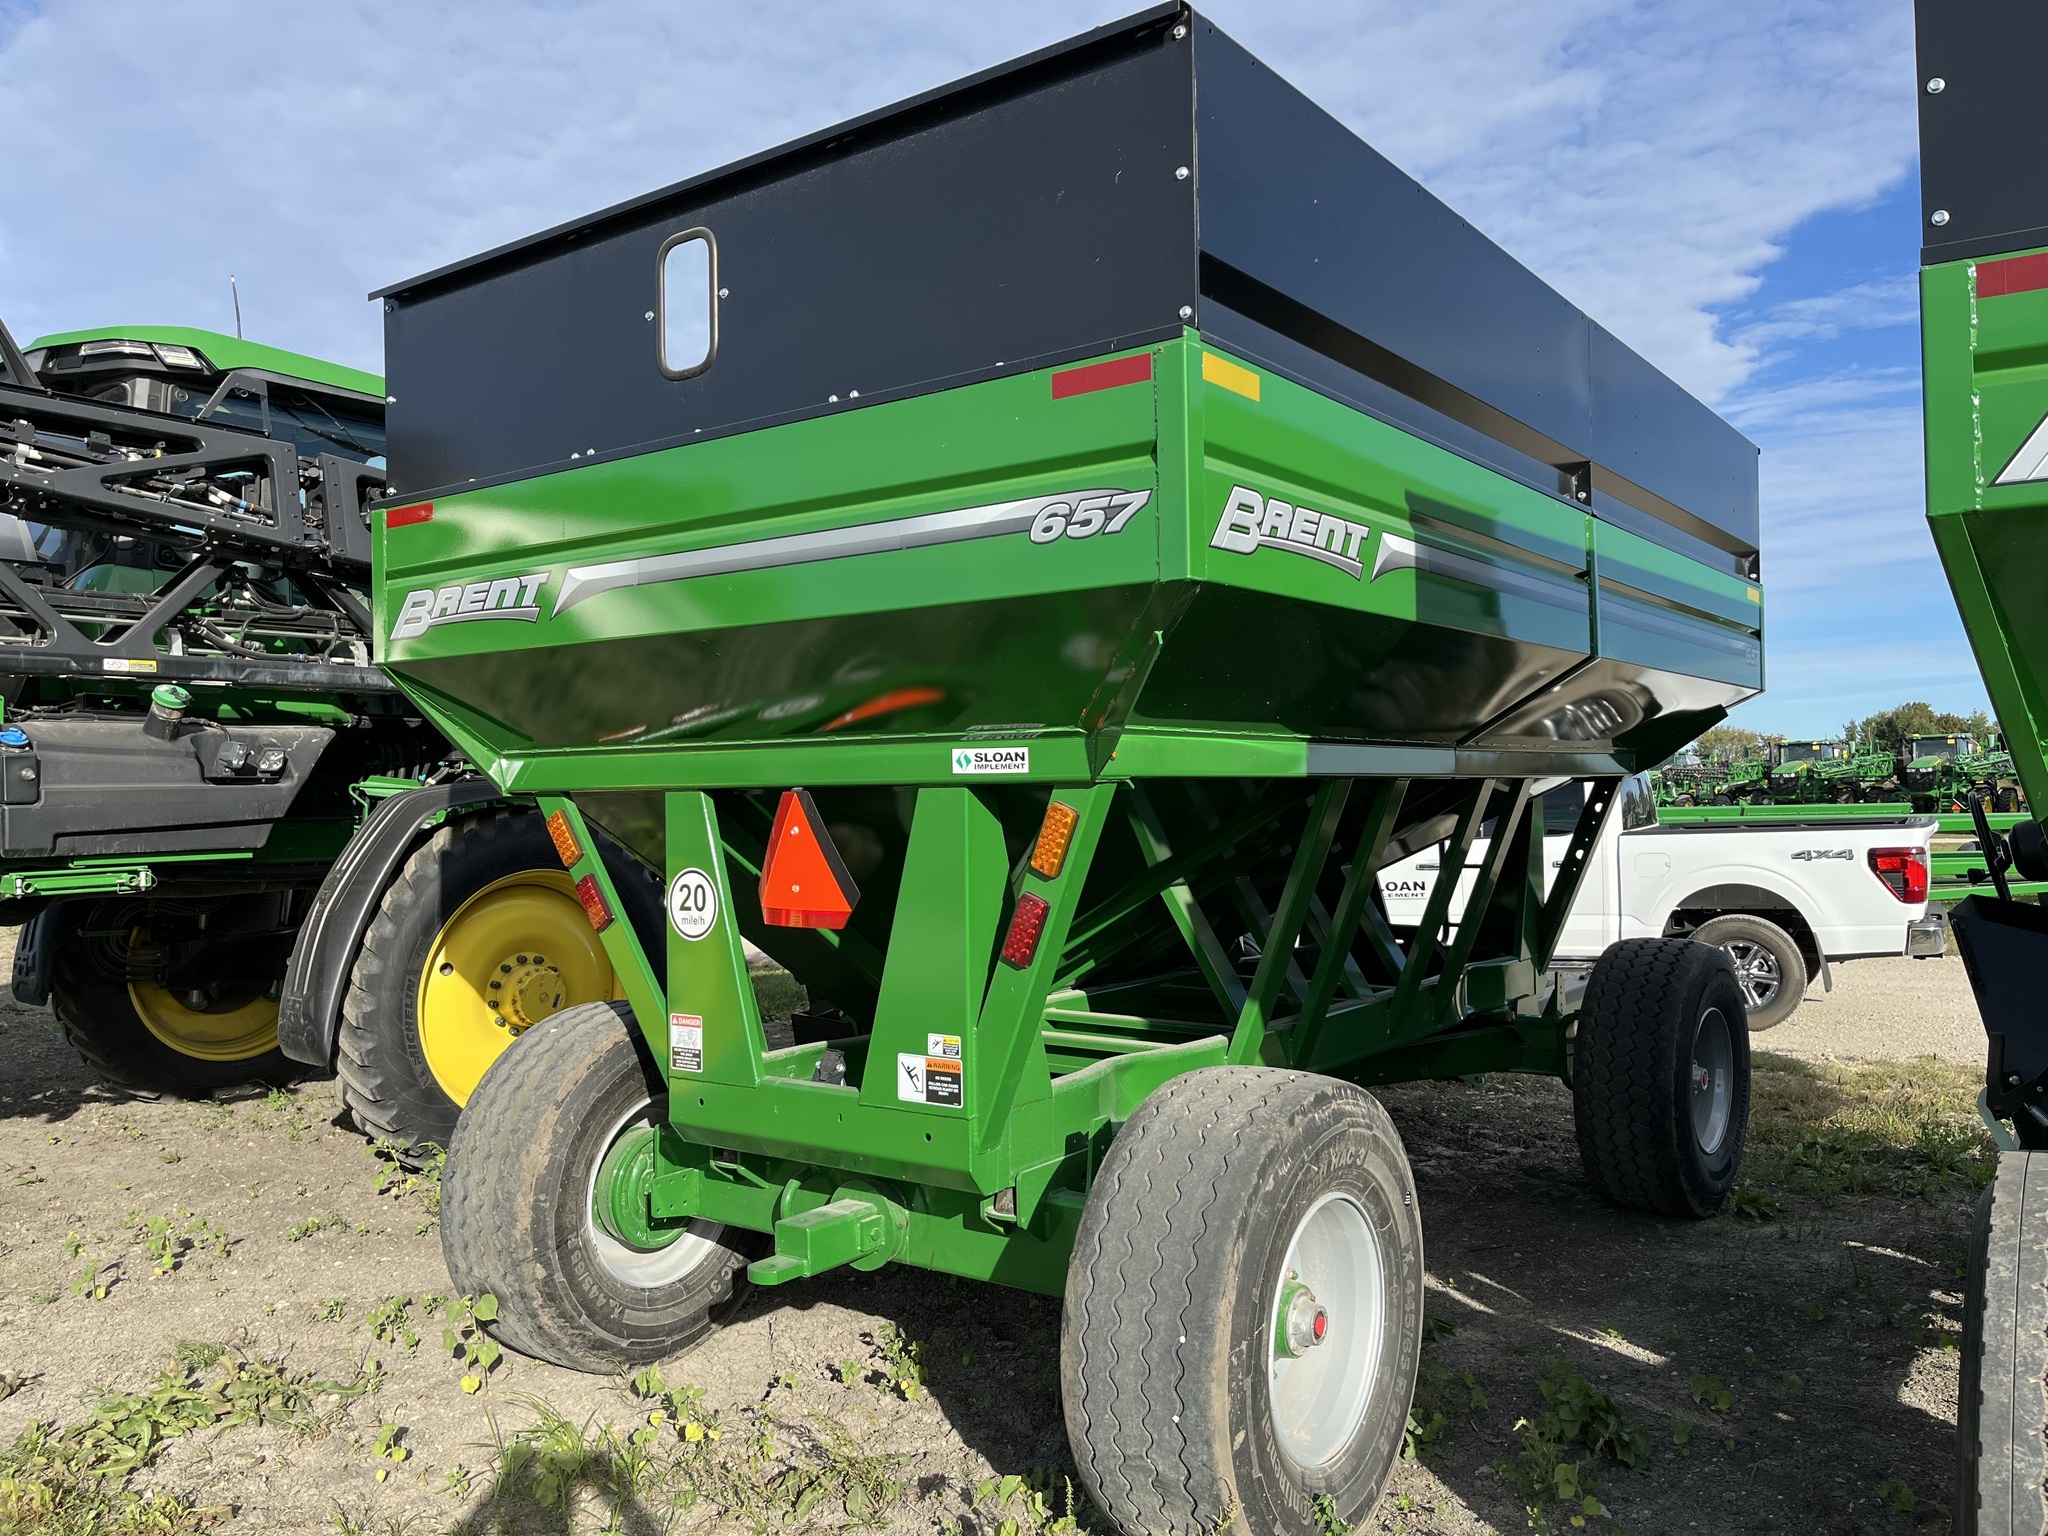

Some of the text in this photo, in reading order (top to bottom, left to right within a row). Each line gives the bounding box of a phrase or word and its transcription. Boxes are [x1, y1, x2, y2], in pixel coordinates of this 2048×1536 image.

[1029, 488, 1153, 545] 657
[1209, 484, 1371, 573] BRENT
[390, 571, 552, 641] BRENT
[974, 752, 1026, 762] SLOAN
[679, 884, 706, 912] 20
[1382, 881, 1426, 892] OAN
[681, 915, 706, 926] mile/h
[404, 978, 421, 1067] MICHELIN
[678, 1017, 701, 1026] DANGER
[933, 1062, 961, 1071] WARNING
[1378, 1279, 1416, 1457] 445/65 R 22.5
[1262, 1410, 1314, 1526] Continental
